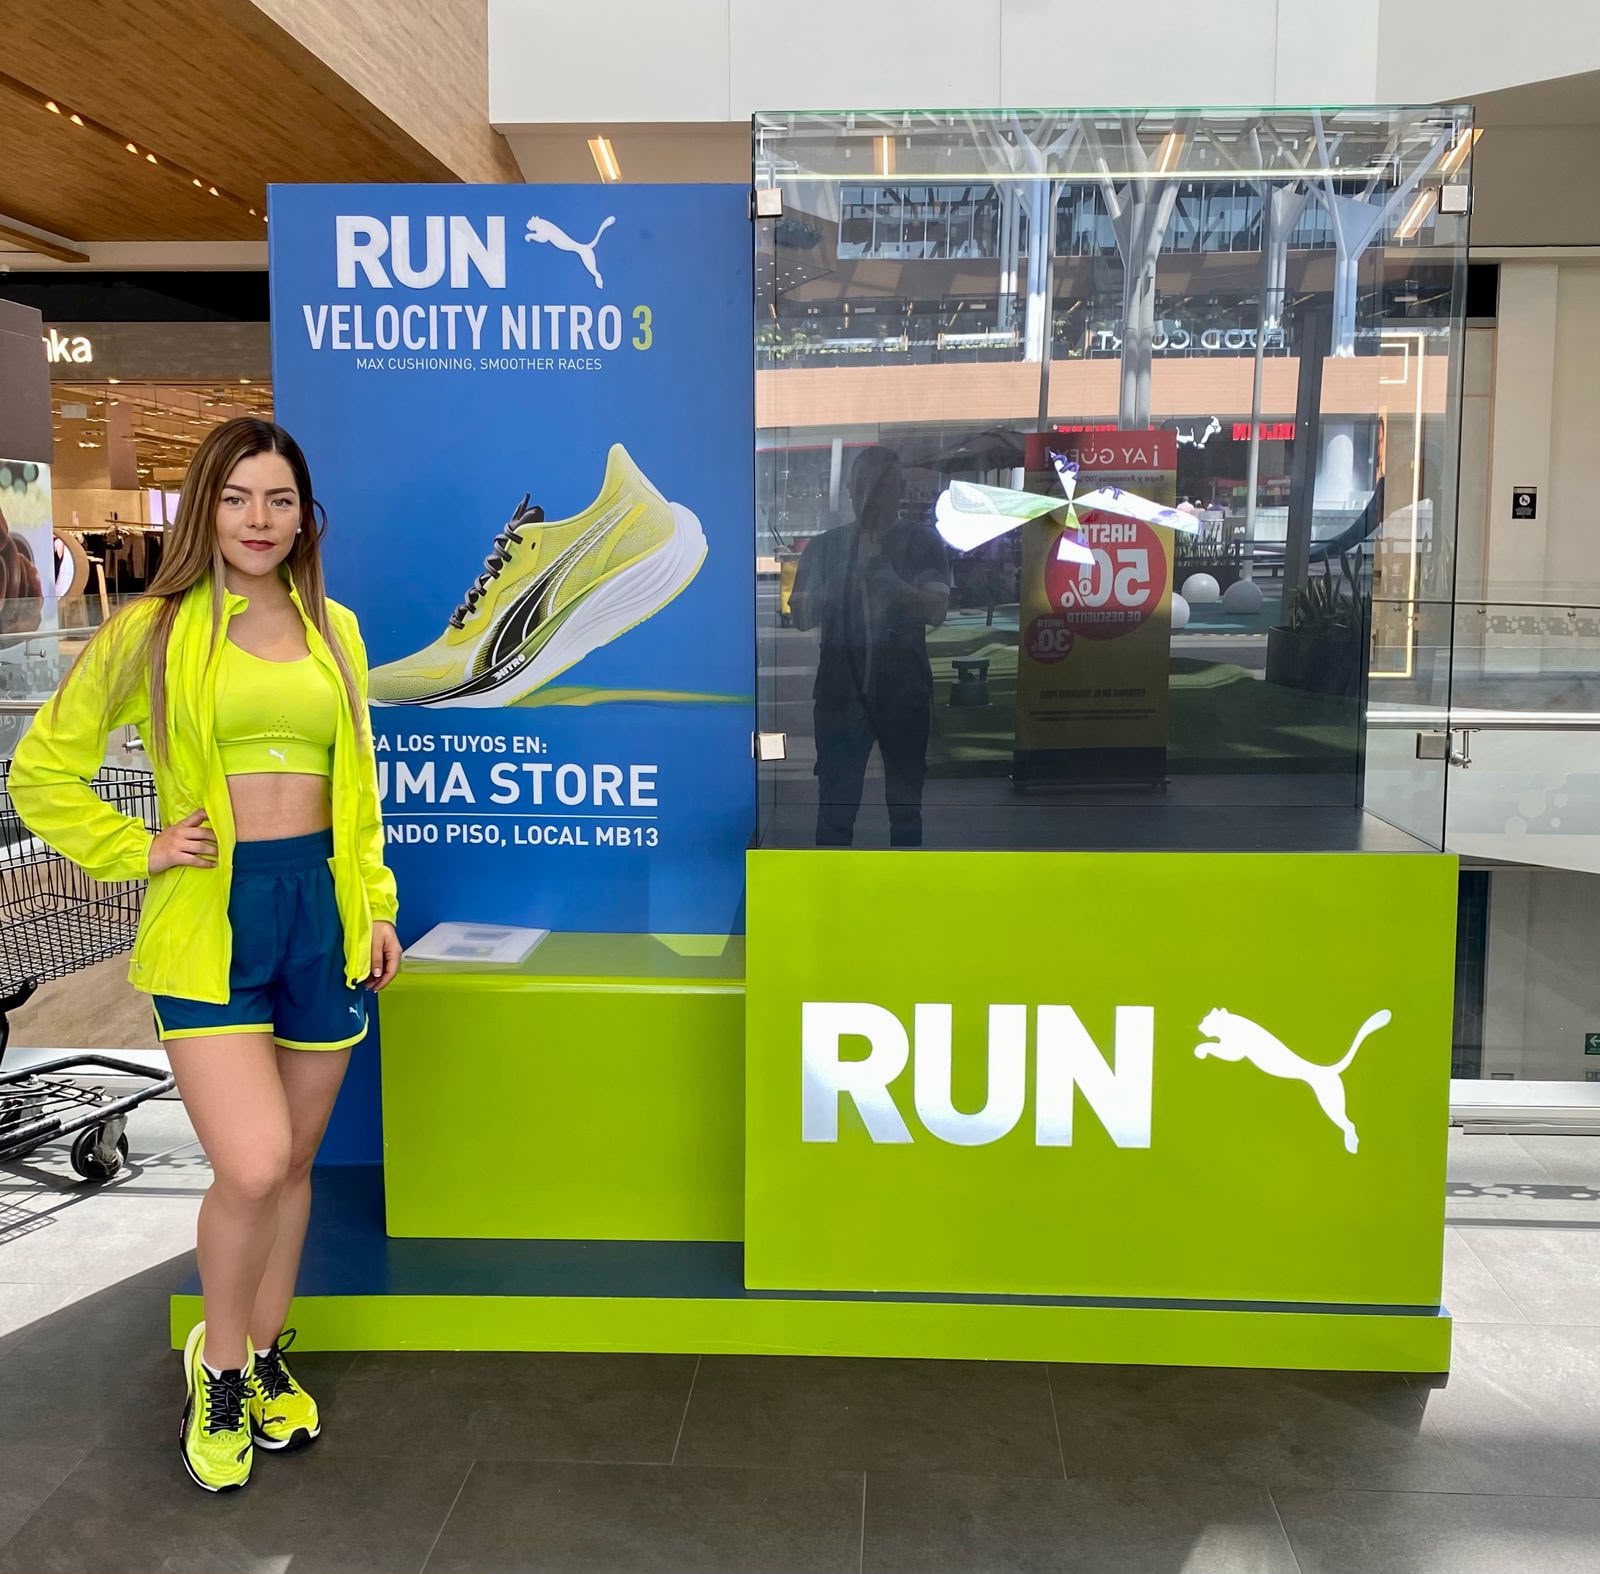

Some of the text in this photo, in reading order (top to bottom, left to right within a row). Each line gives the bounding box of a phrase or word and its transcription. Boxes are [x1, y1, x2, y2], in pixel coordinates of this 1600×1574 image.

[336, 215, 506, 289] RUN
[302, 305, 653, 350] VELOCITY NITRO 3
[356, 357, 602, 373] MAX CUSHIONING, SMOOTHER RACES
[490, 653, 526, 681] NITRO
[396, 734, 435, 752] LOS
[440, 735, 507, 753] TUYOS
[512, 736, 548, 754] EN:
[489, 763, 658, 807] STORE
[383, 824, 659, 848] NDO PISO, LOCAL MB13
[801, 1001, 1155, 1149] RUN
